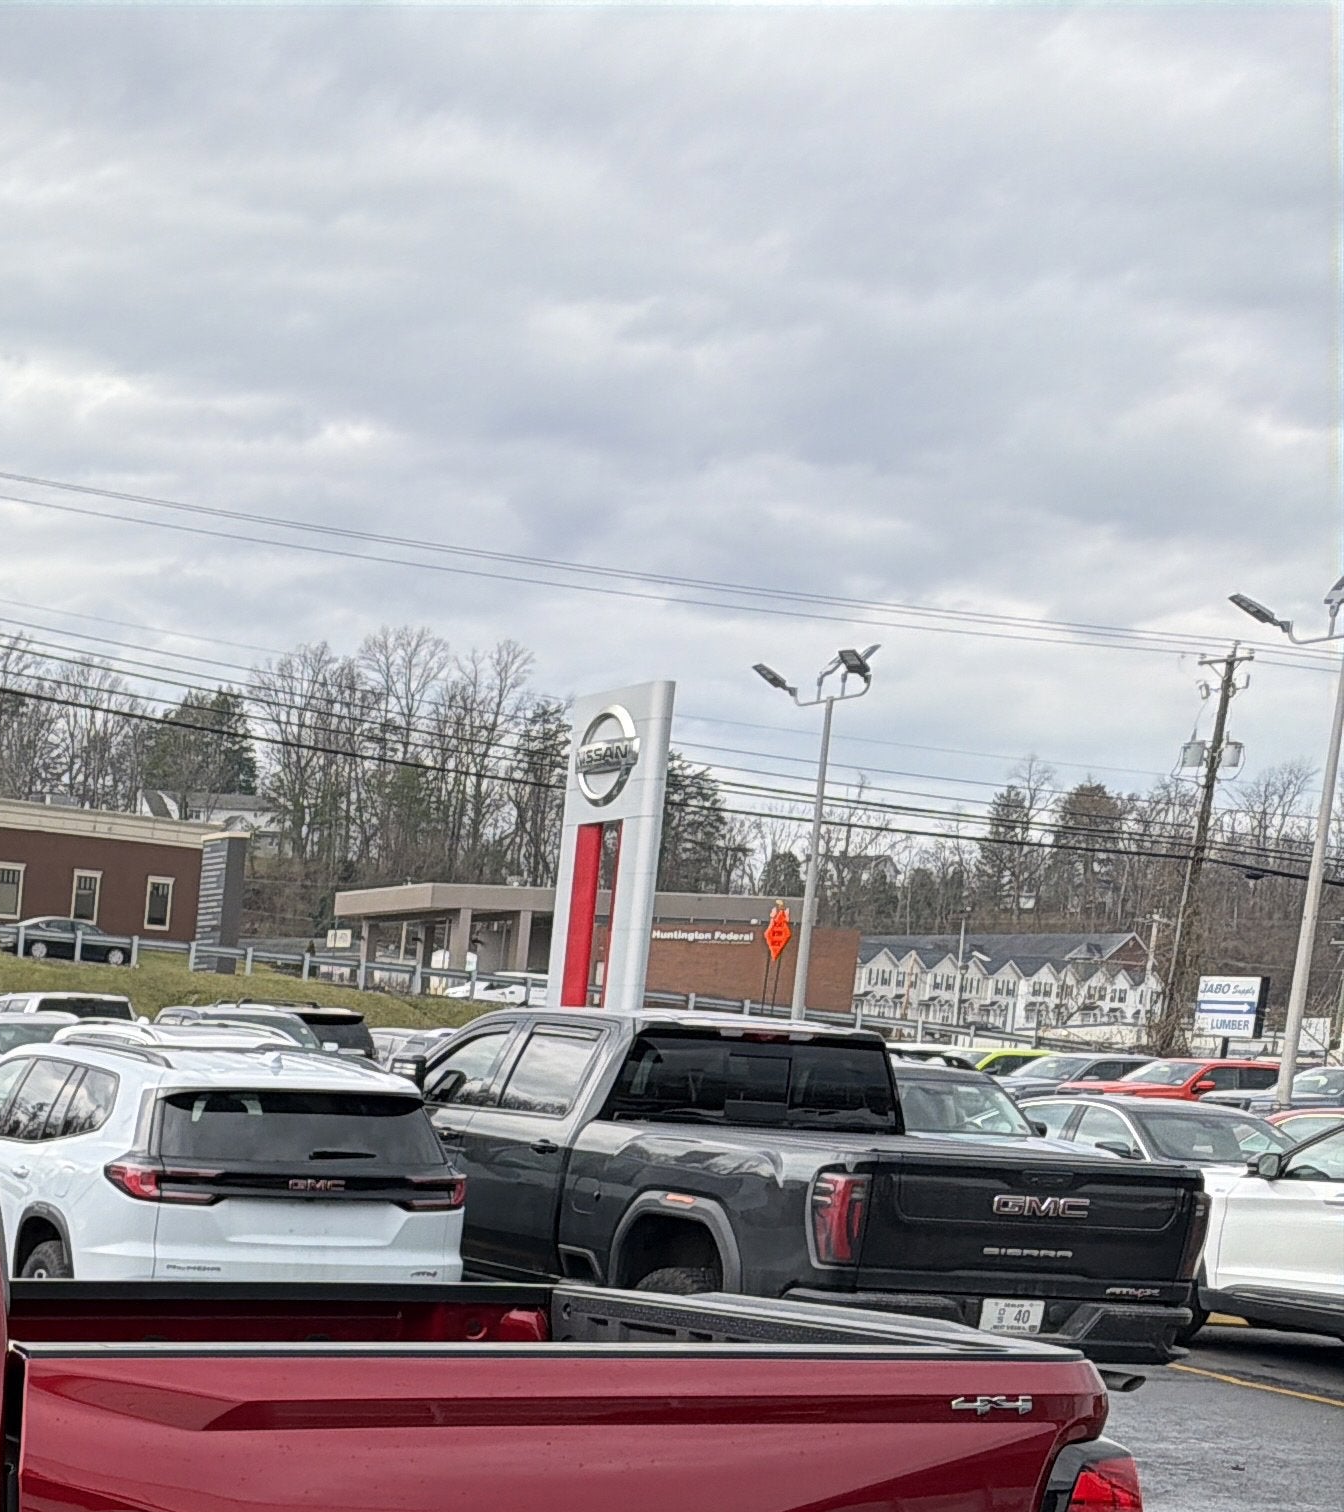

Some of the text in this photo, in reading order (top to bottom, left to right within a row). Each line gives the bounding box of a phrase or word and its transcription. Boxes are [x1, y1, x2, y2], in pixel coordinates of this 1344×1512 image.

[652, 930, 754, 941] Huntington Federal
[1200, 983, 1231, 995] JABO
[1210, 1019, 1250, 1031] LUMBER
[288, 1179, 346, 1192] GMC
[993, 1195, 1090, 1218] GMC
[1013, 1309, 1031, 1324] 40
